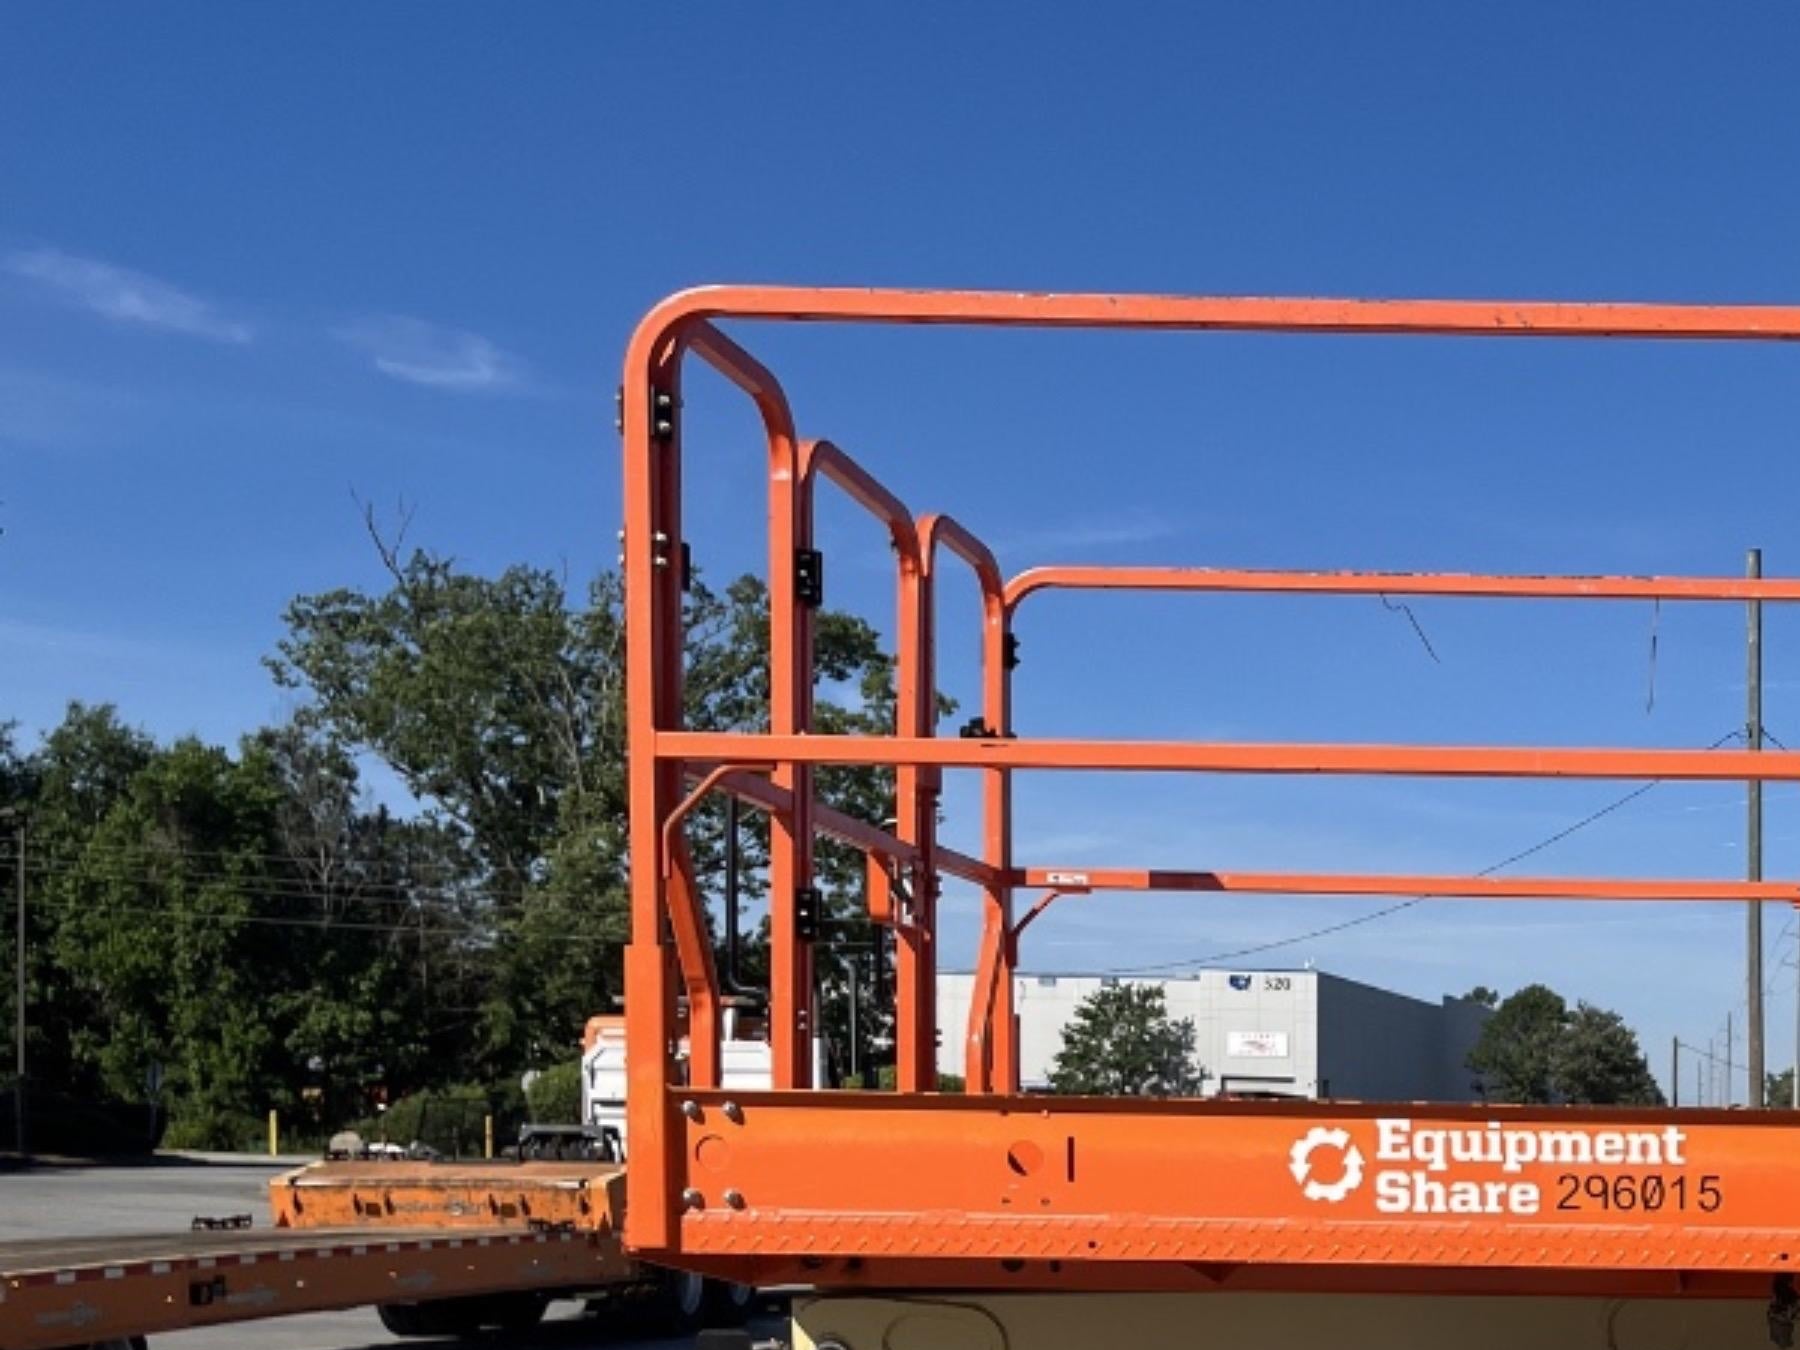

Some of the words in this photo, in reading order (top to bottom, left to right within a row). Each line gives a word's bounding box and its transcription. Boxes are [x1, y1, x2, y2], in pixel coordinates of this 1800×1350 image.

[1374, 1118, 1687, 1172] Equipment
[1374, 1170, 1541, 1214] Share
[1555, 1173, 1723, 1213] 296015
